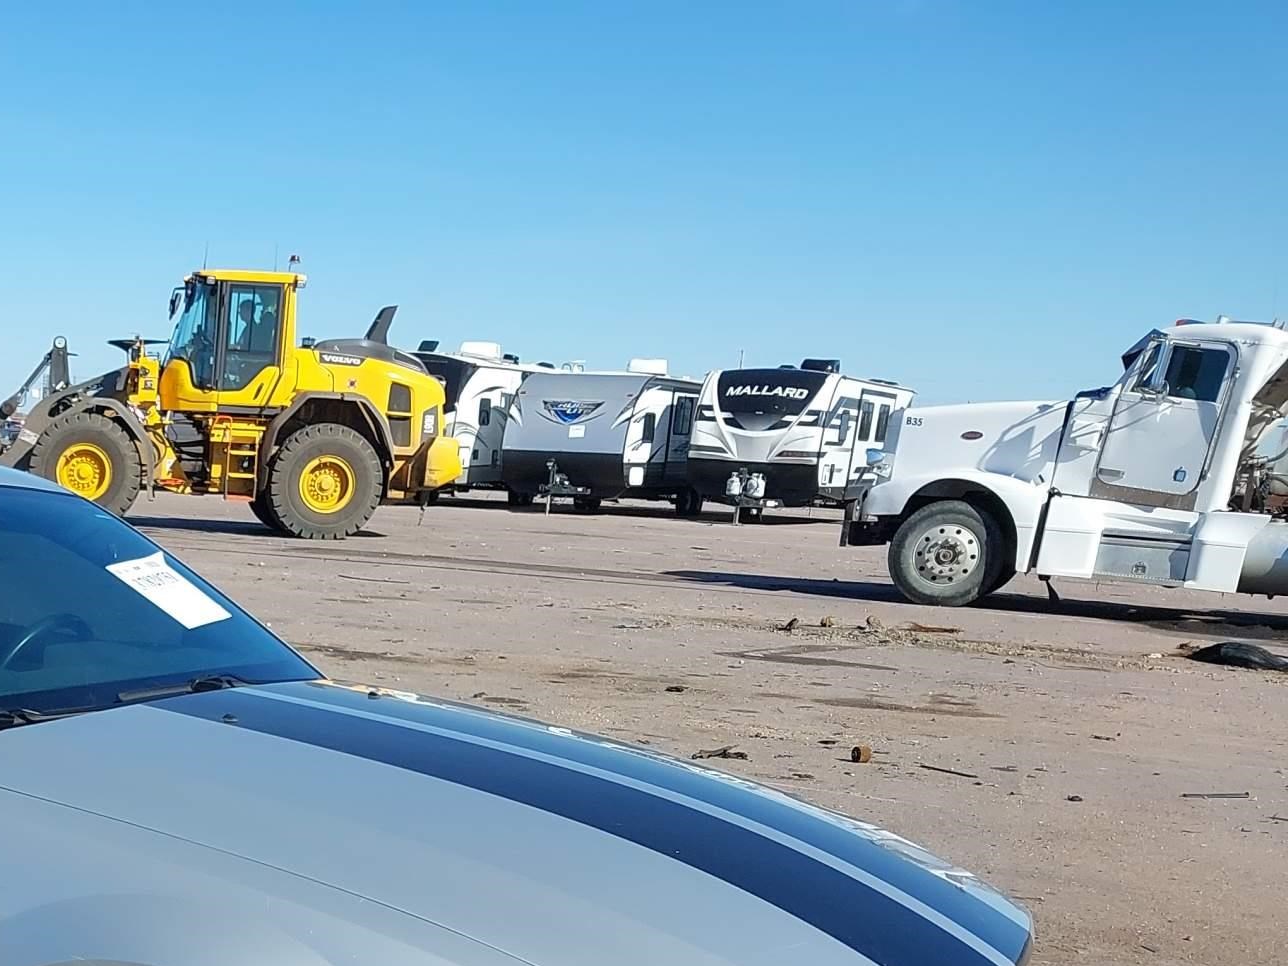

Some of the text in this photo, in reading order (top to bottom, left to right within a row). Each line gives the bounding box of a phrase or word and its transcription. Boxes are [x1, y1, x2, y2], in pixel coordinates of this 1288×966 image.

[322, 354, 361, 365] VOLVO
[725, 385, 809, 400] MALLARD
[906, 416, 925, 427] B35
